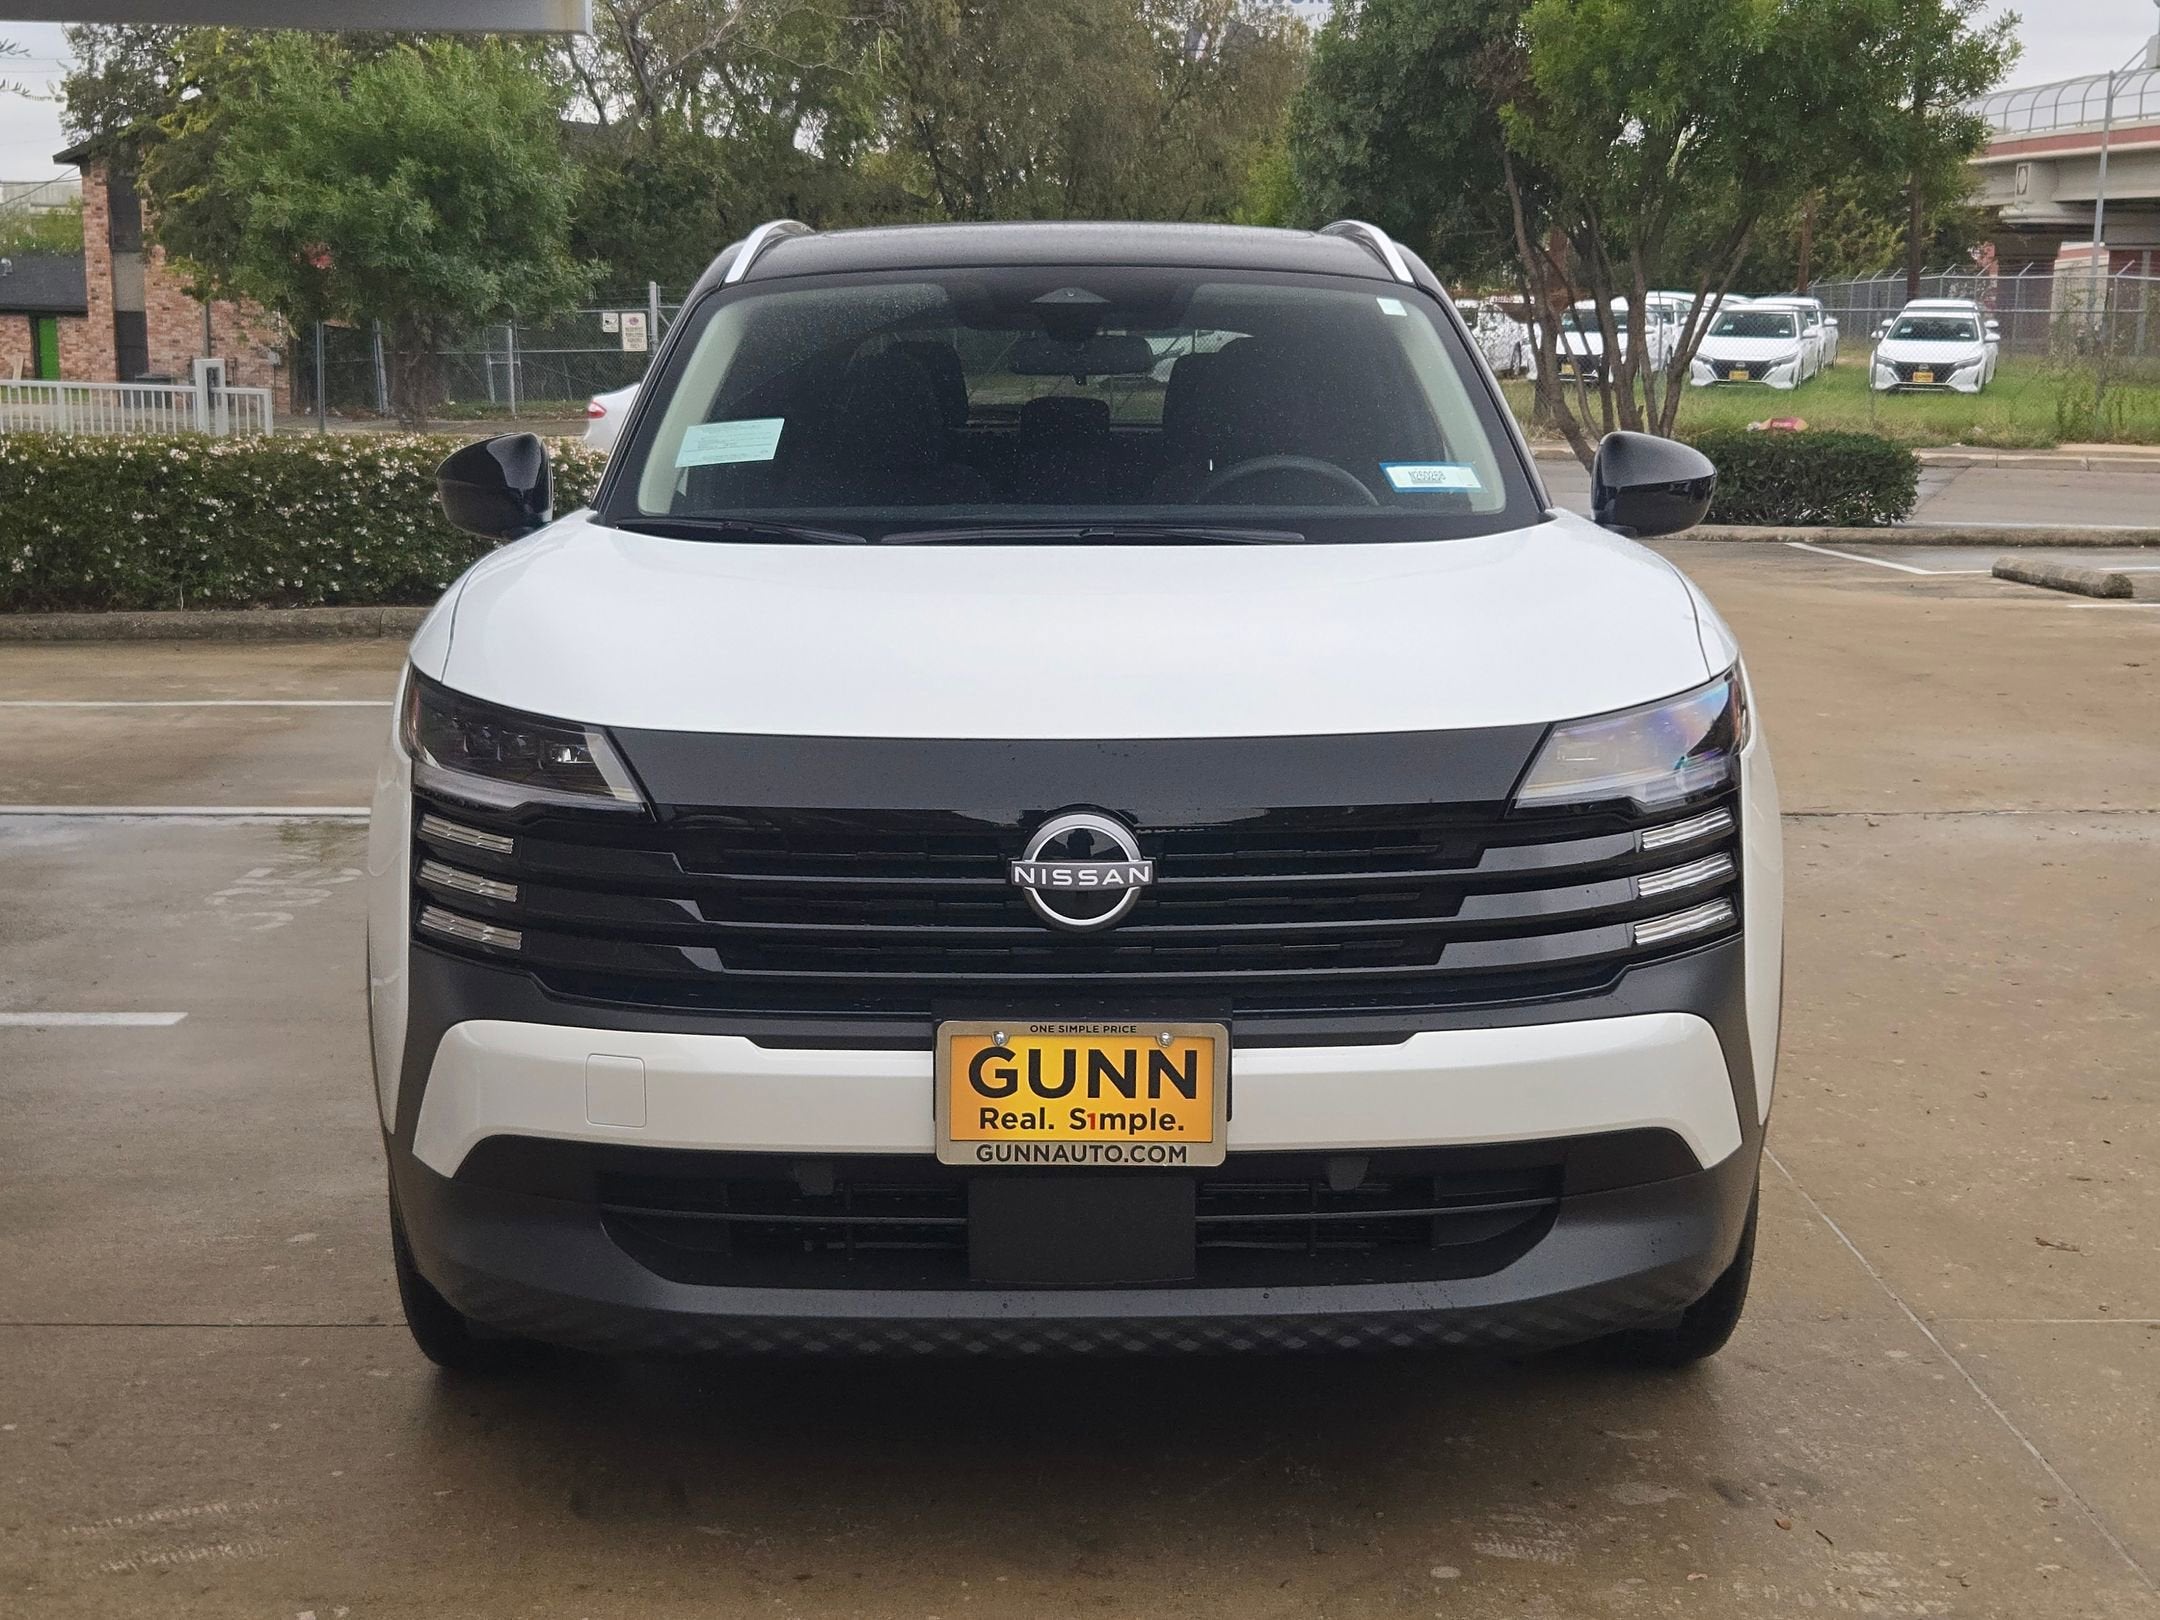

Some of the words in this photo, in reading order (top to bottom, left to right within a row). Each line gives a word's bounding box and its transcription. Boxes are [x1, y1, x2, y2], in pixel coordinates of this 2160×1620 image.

[1014, 866, 1149, 886] NISSAN
[1029, 1025, 1055, 1034] ONE
[1058, 1025, 1100, 1034] SIMPLE
[1103, 1025, 1137, 1034] PRICE
[968, 1046, 1198, 1100] GUNN
[979, 1108, 1055, 1130] Real.
[976, 1144, 1187, 1163] GUNNAUTO.COM
